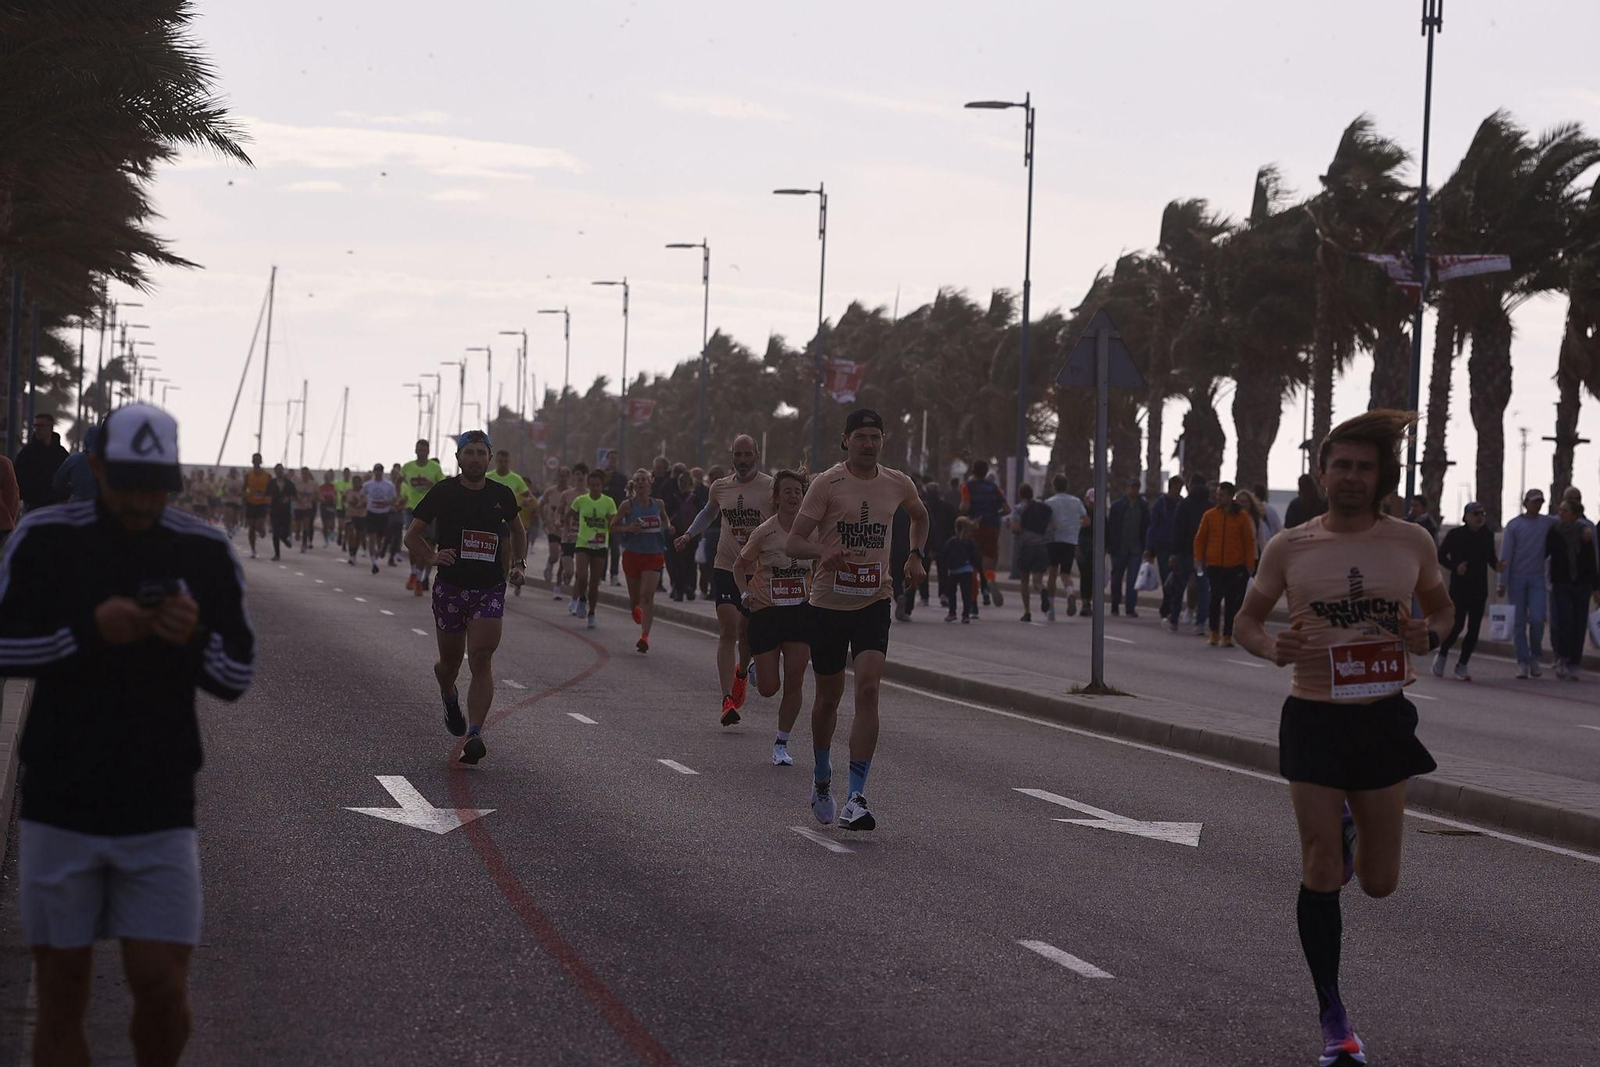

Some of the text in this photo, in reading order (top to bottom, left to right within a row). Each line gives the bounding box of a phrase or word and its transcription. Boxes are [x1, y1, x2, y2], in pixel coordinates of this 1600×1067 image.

[722, 508, 760, 518] BRUNCH
[837, 521, 887, 537] BRUNCH
[481, 541, 496, 550] 1351
[841, 533, 868, 549] RUN
[859, 574, 876, 583] 848
[790, 586, 802, 594] 329
[1310, 598, 1399, 617] BRUNCH
[1371, 659, 1399, 674] 414
